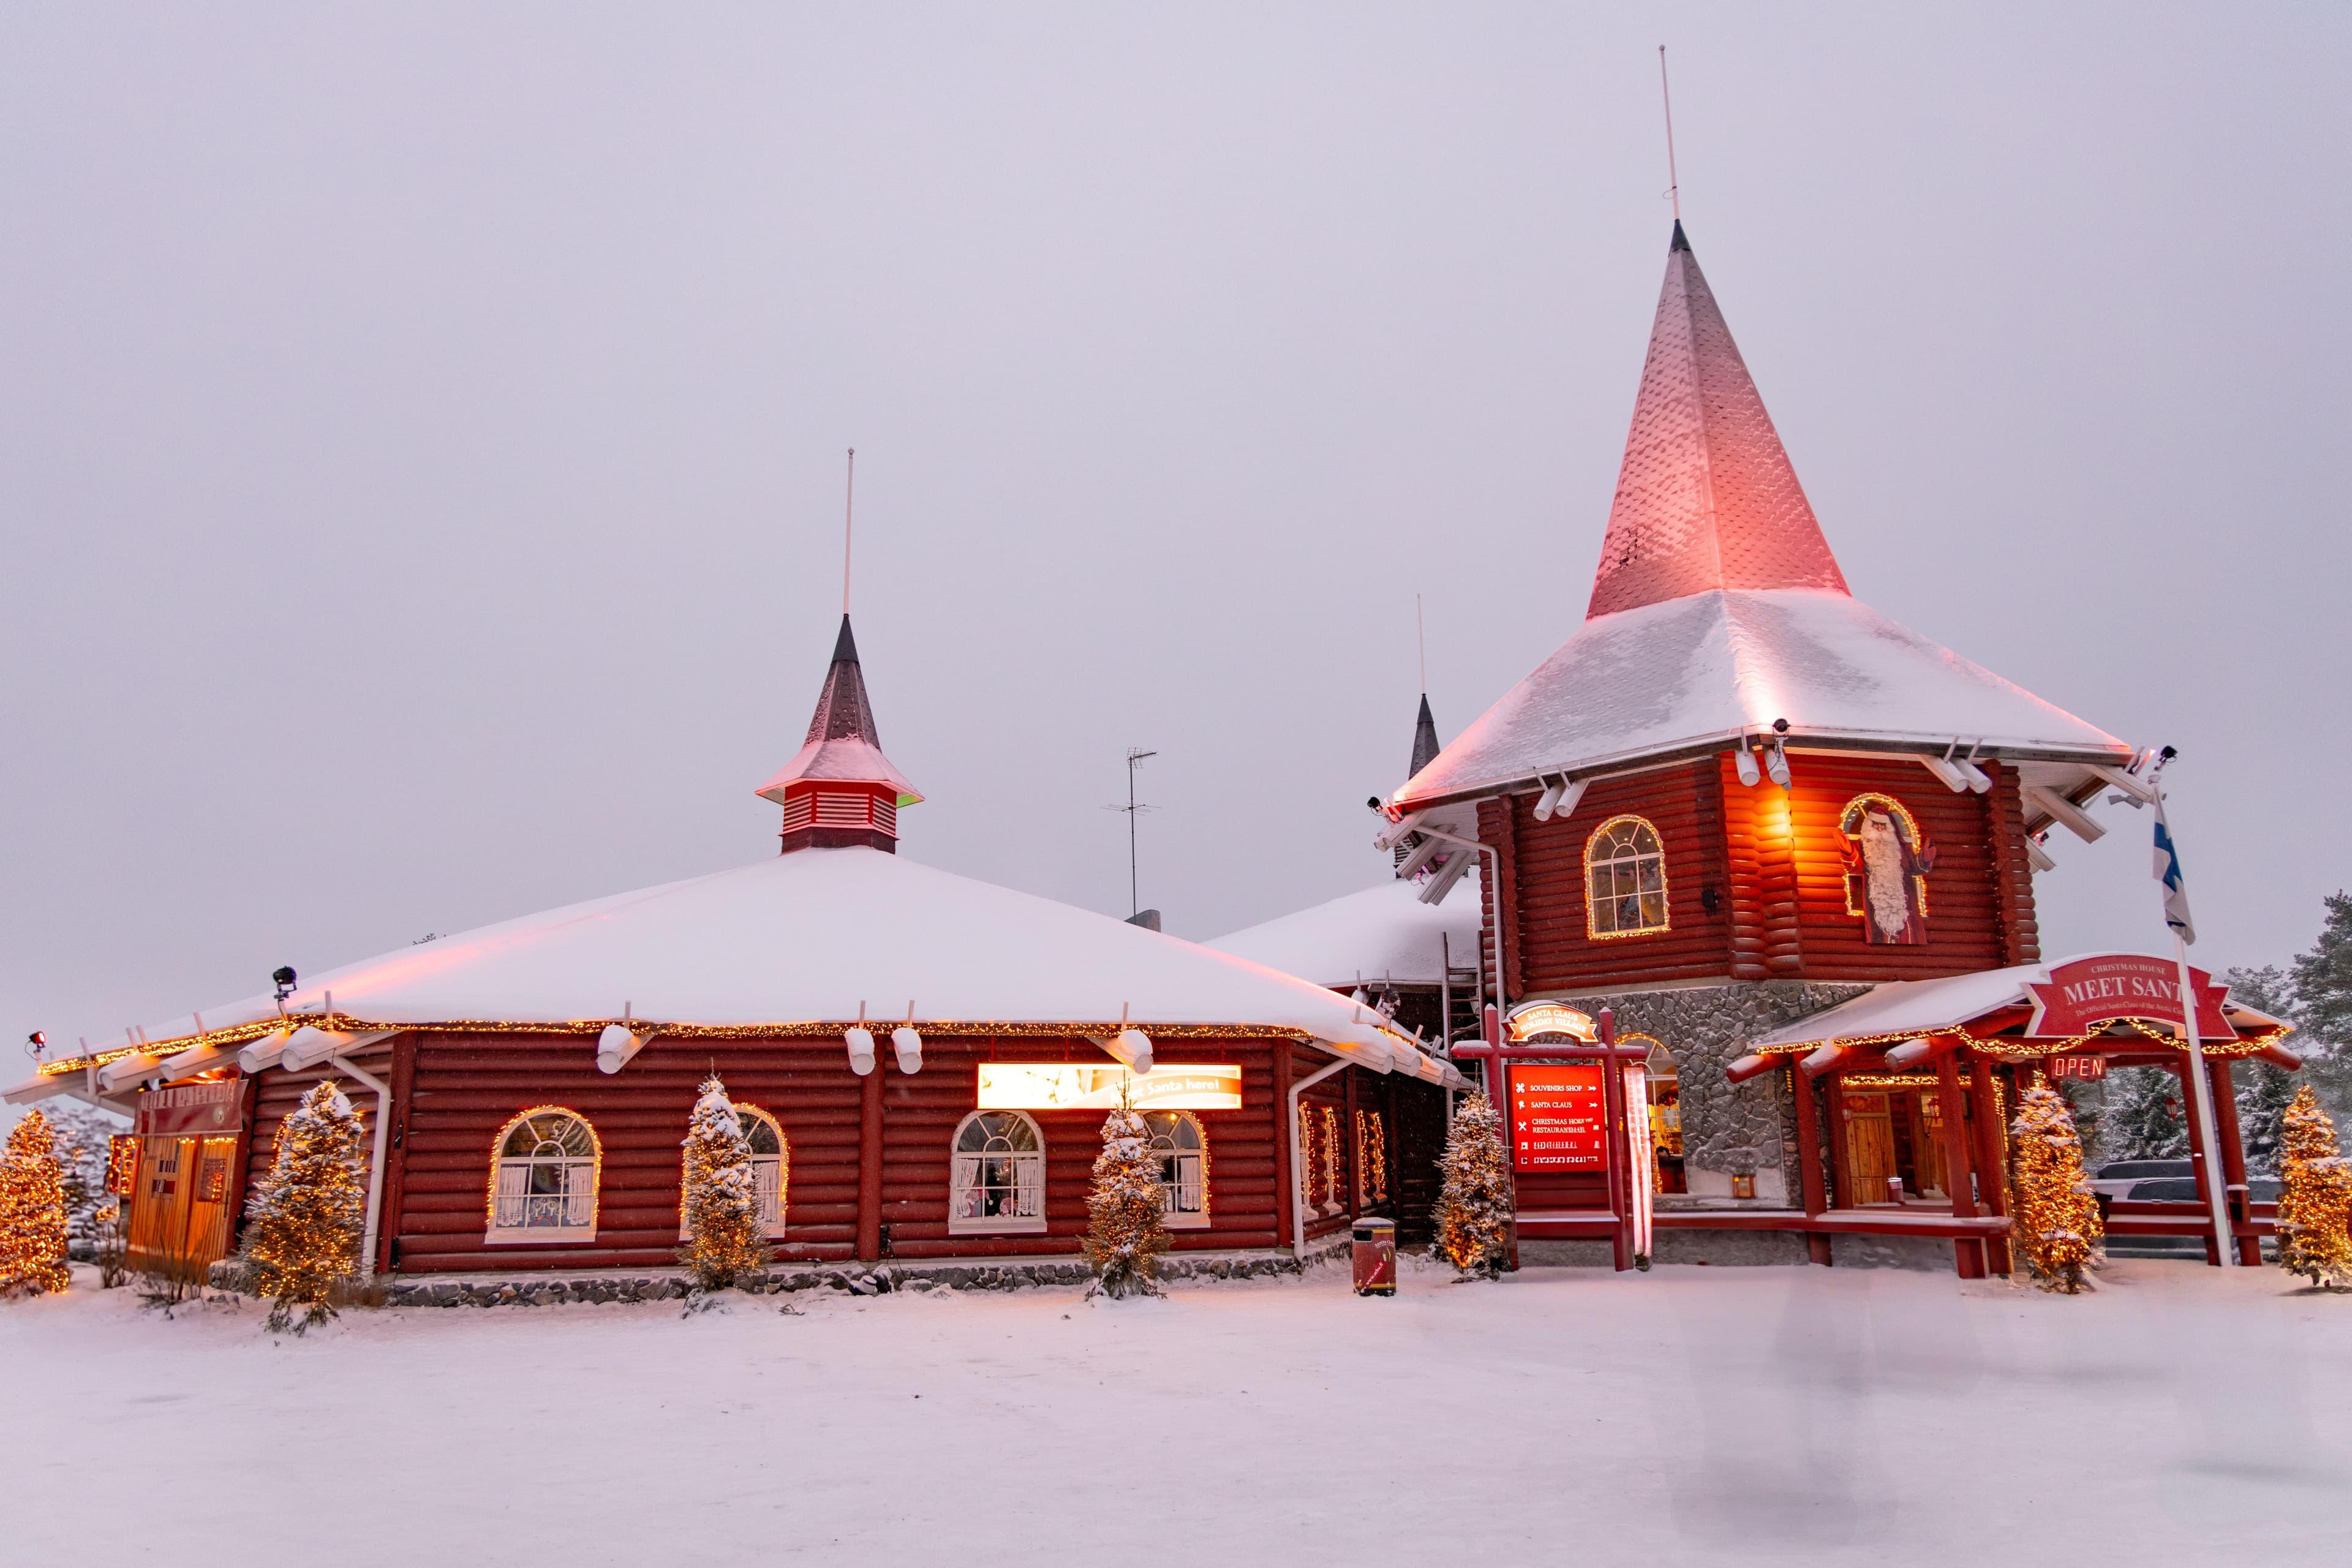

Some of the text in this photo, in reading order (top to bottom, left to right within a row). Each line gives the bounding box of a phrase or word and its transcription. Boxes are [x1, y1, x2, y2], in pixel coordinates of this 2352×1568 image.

[2091, 963, 2166, 975] CHRISTMAS HOUSE
[2063, 977, 2126, 1005] MEET
[1527, 1009, 1578, 1021] SANTA CLAUS
[2086, 1005, 2107, 1014] Official
[1520, 1017, 1587, 1033] HOLIDAY VILLAGE
[2055, 1058, 2102, 1076] OPEN
[1147, 1080, 1183, 1095] Santa
